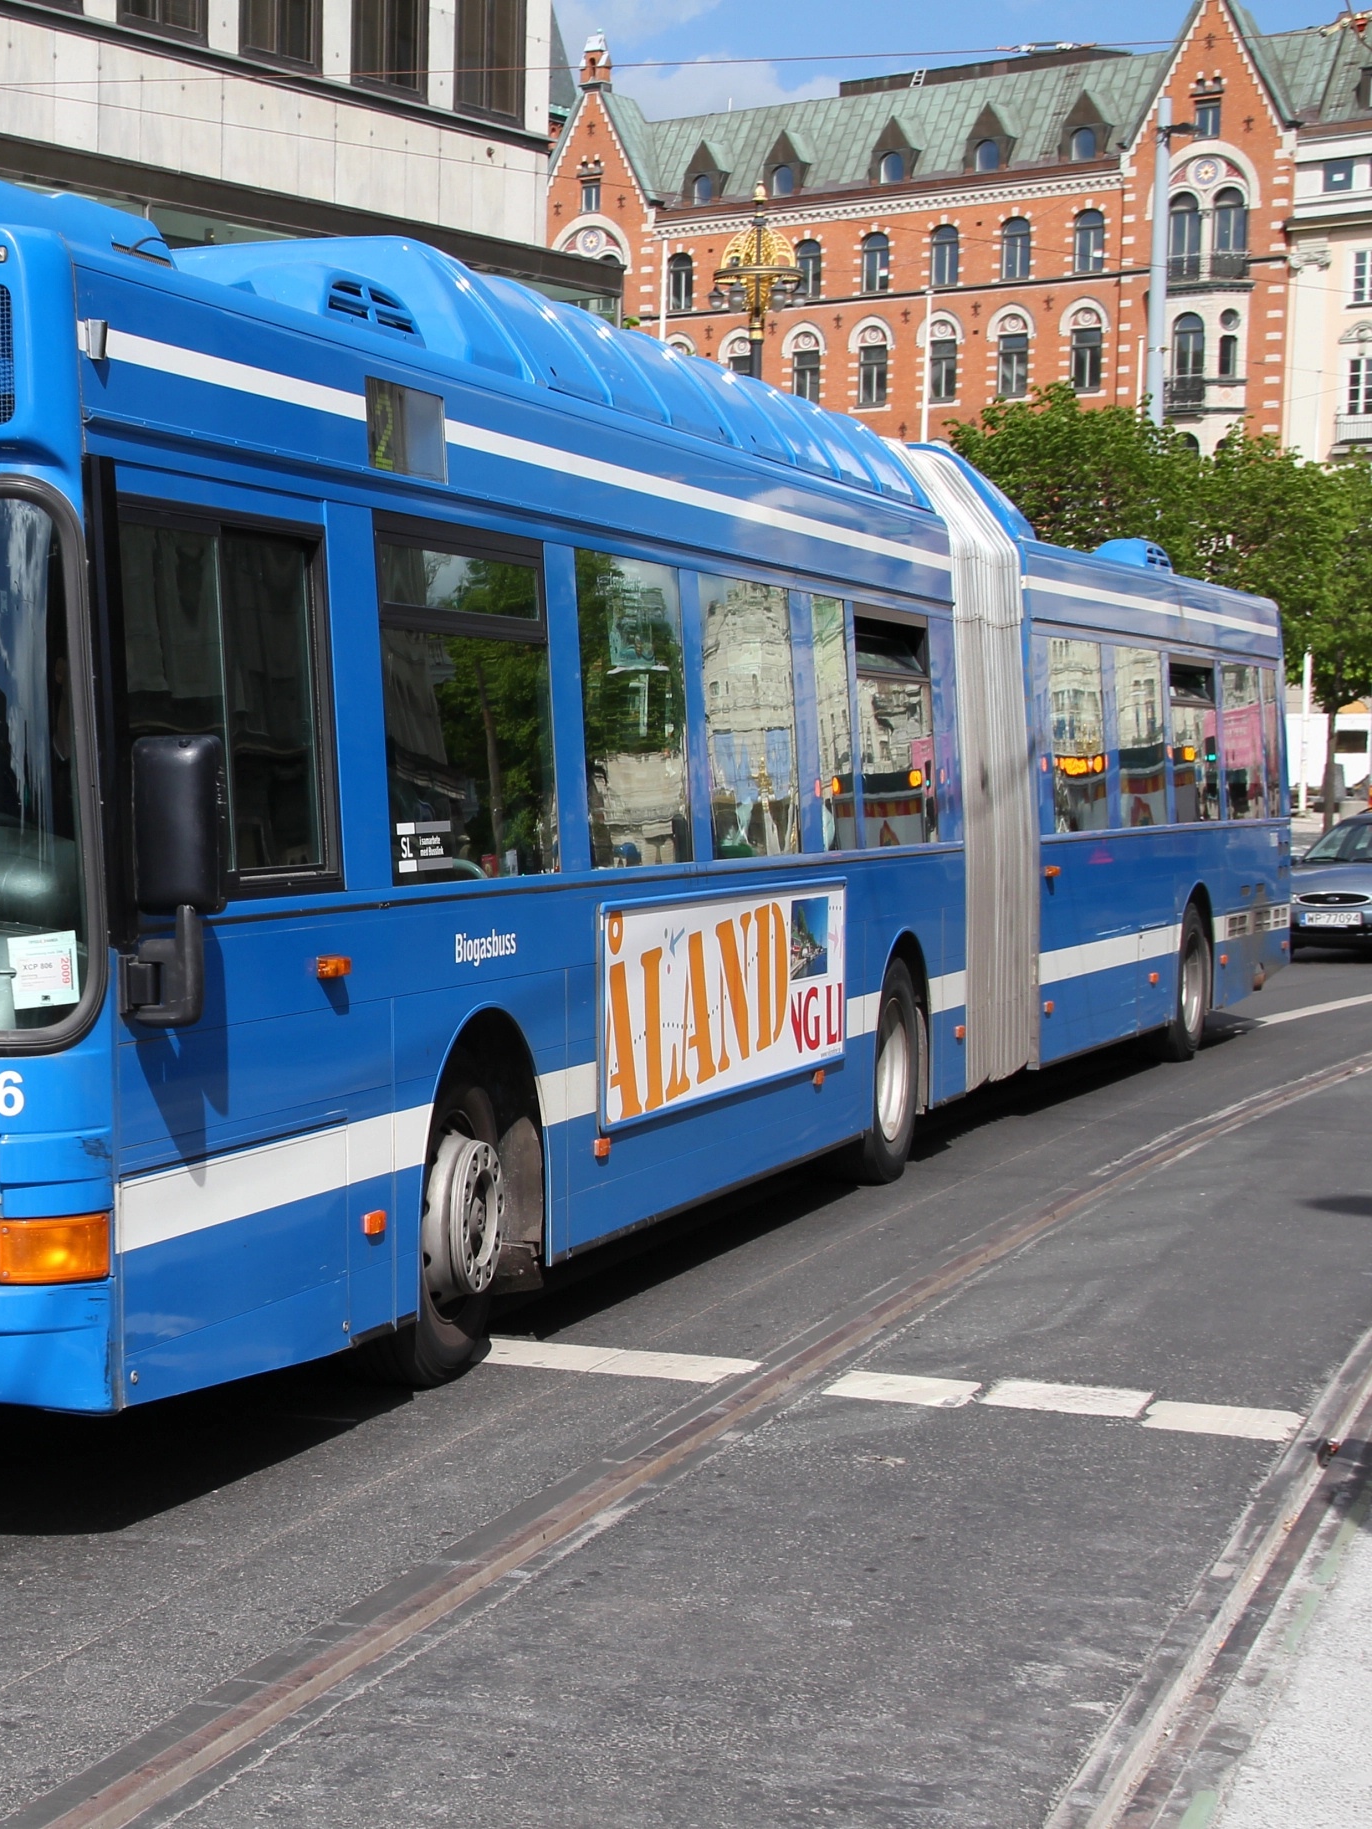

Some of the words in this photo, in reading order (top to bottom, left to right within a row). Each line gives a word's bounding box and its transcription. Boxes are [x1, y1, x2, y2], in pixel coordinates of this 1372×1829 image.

[374, 393, 394, 471] 2
[401, 836, 414, 859] SL
[1307, 914, 1321, 924] WP
[1325, 913, 1360, 924] 77094
[455, 928, 516, 967] Biogasbuss
[22, 963, 39, 971] XCP
[40, 962, 53, 970] 806
[60, 957, 71, 984] 2009
[605, 902, 788, 1125] ÅLAND
